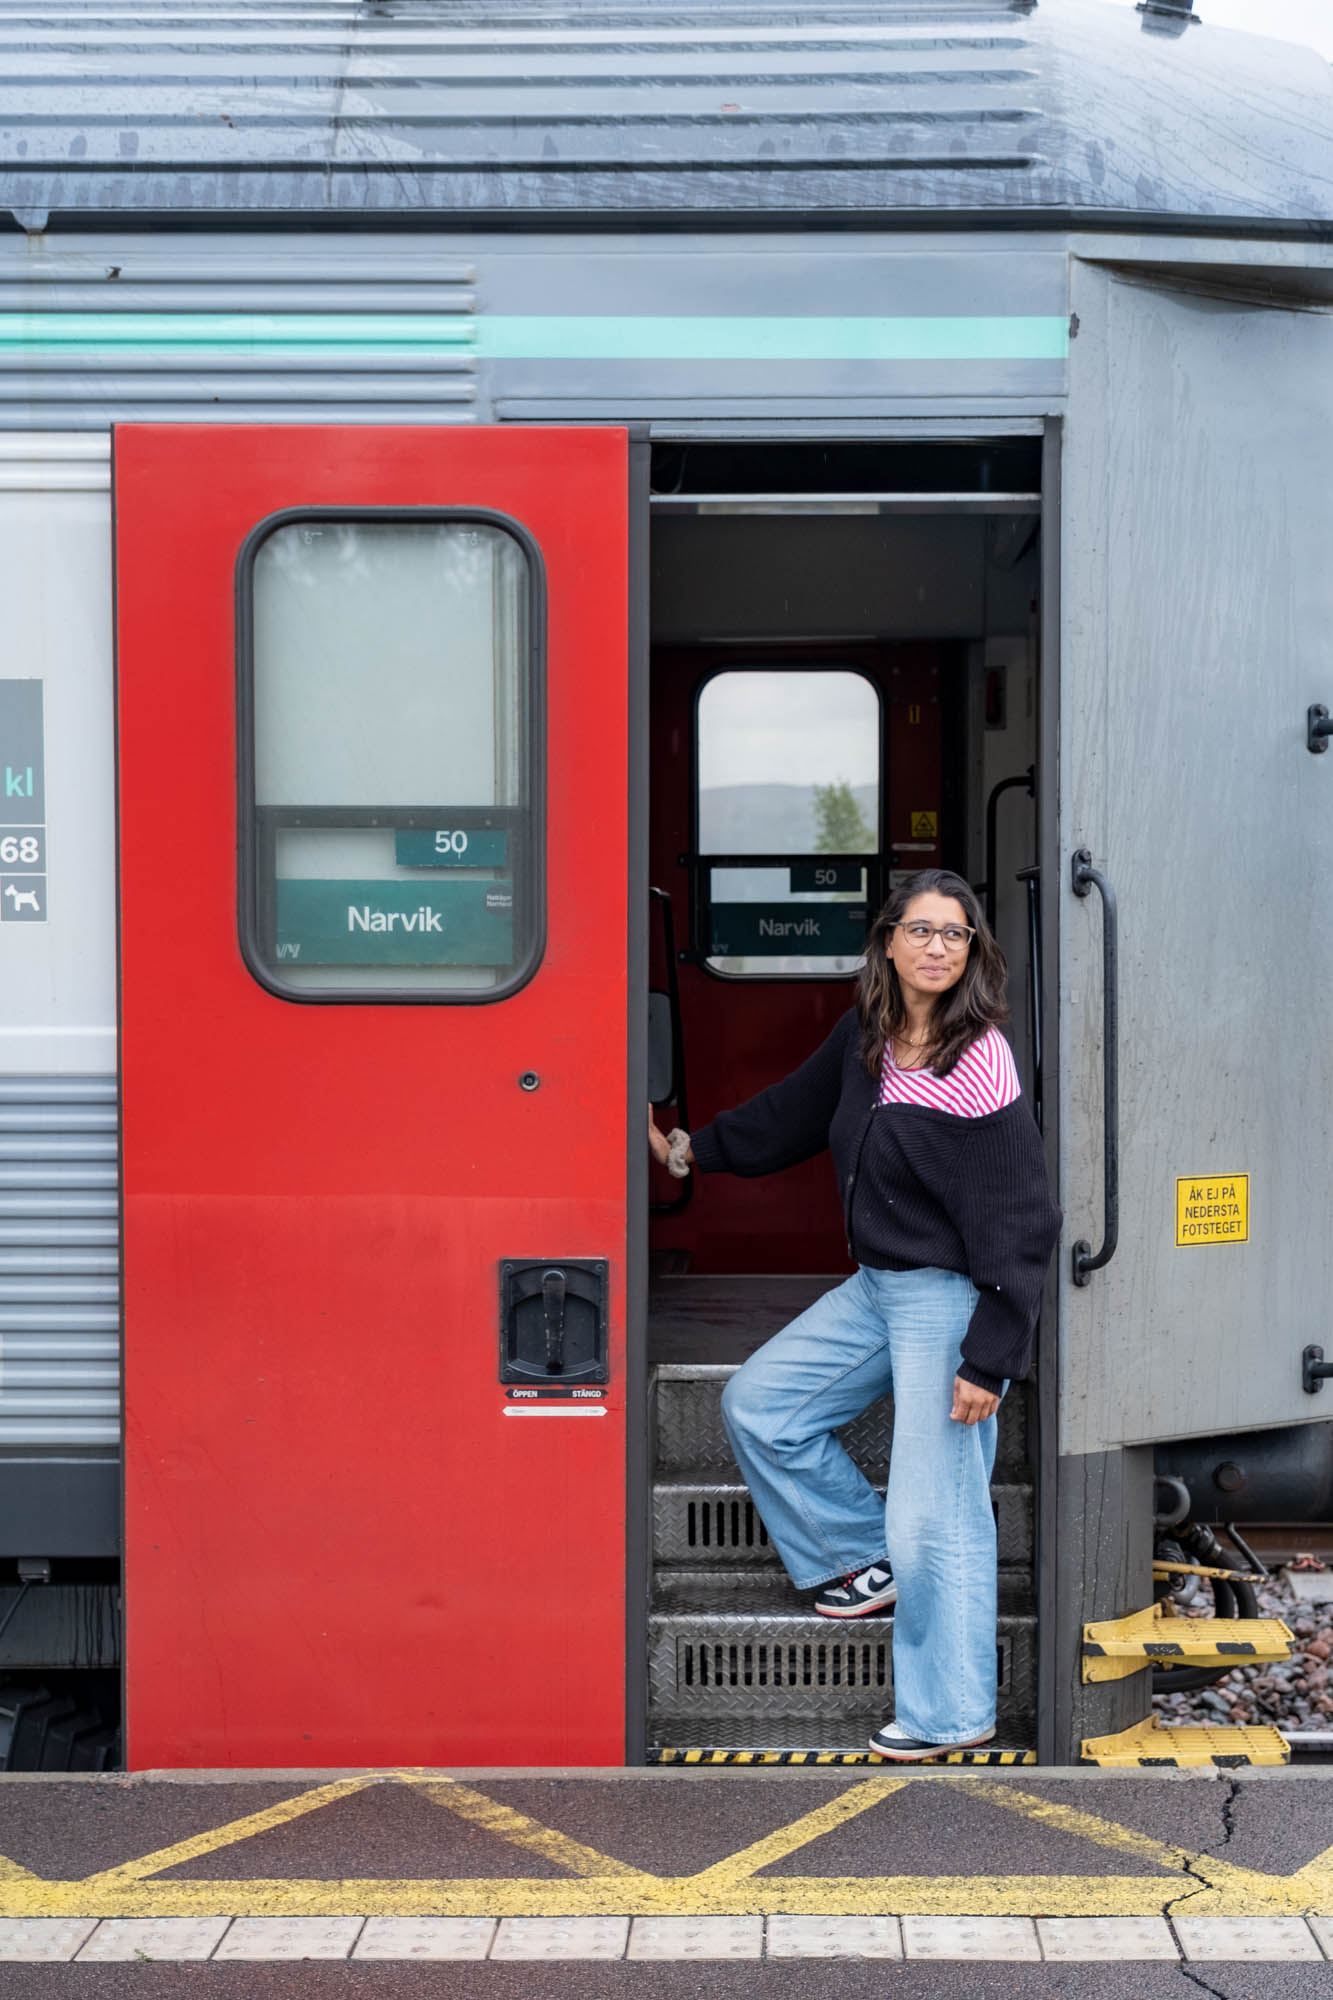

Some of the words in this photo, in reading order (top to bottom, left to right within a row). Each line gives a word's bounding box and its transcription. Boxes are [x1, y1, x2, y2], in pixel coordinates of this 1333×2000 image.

[5, 767, 33, 796] kl
[0, 836, 39, 863] 68
[434, 831, 468, 853] 50
[815, 869, 837, 885] 50
[348, 906, 443, 932] Narvik
[759, 918, 820, 937] Narvik
[1189, 1186, 1203, 1201] ÅK
[1207, 1188, 1219, 1200] EJ
[1222, 1184, 1236, 1199] PÅ
[1185, 1204, 1240, 1219] NEDERSTA
[1182, 1220, 1242, 1237] FOTSTEGET
